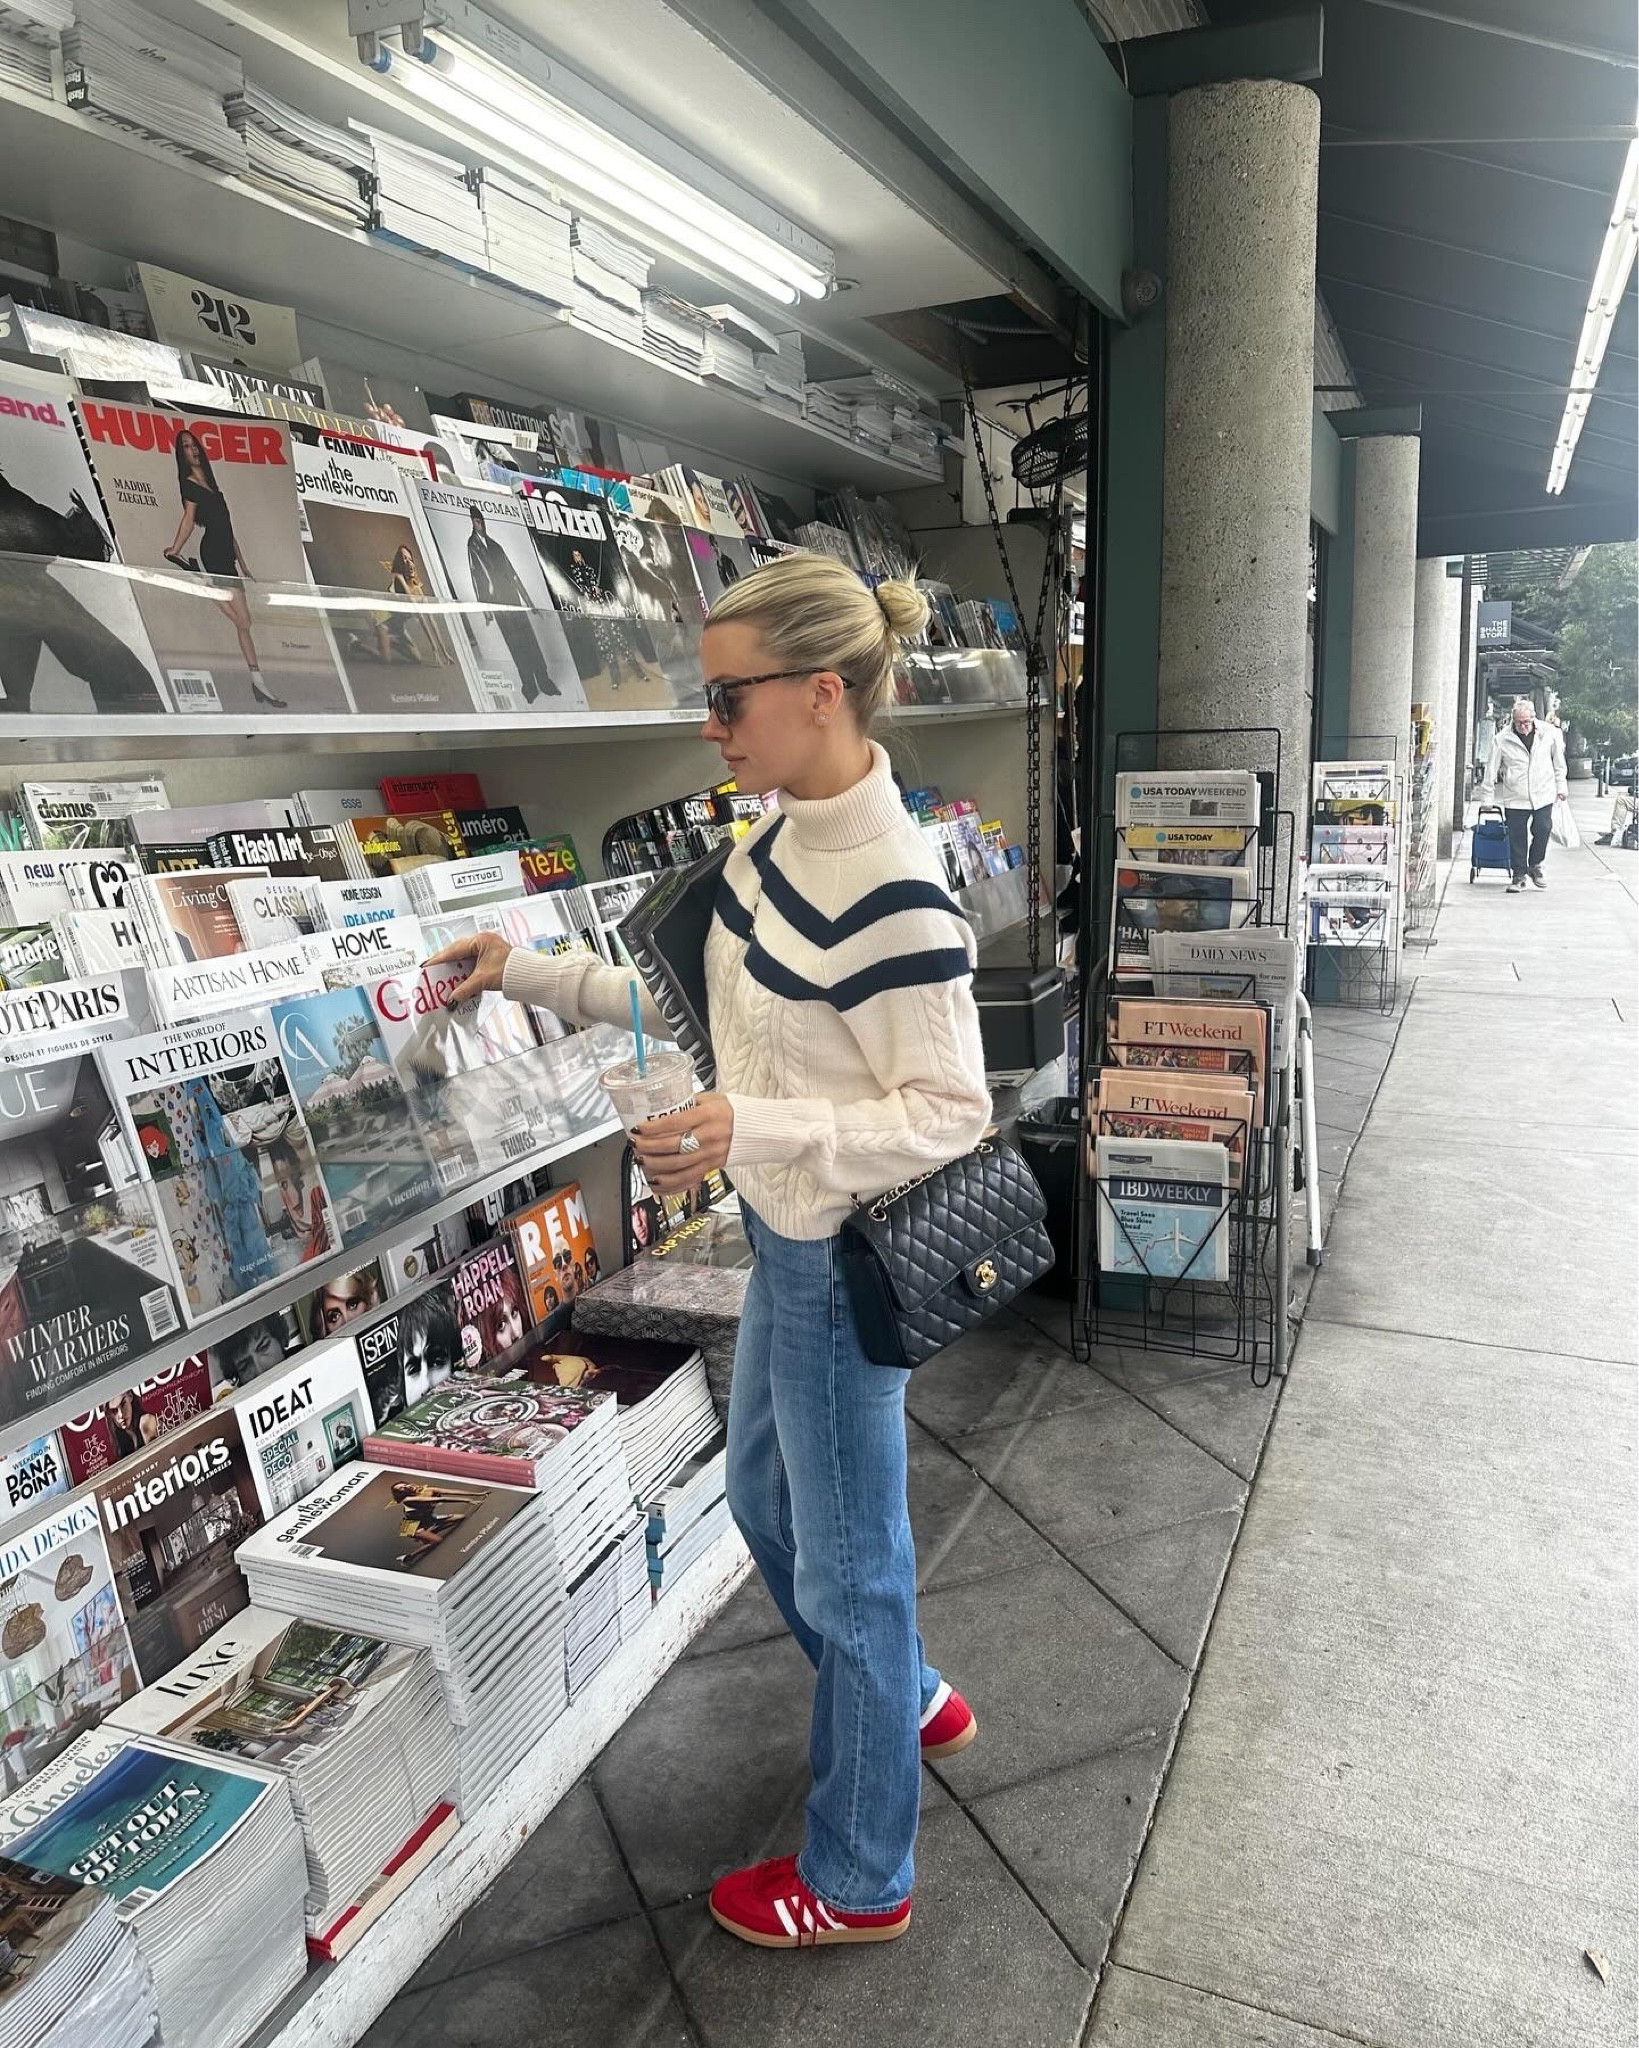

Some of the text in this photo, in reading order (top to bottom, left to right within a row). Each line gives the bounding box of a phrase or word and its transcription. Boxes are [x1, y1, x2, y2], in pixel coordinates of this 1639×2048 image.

[191, 289, 257, 346] 212
[81, 402, 288, 466] HUNGER
[328, 457, 354, 482] the
[113, 477, 153, 495] MADDIE
[117, 490, 159, 508] ZIEGLER
[295, 470, 399, 504] gentlewoman
[531, 496, 607, 541] DAZED
[1143, 786, 1247, 797] USA TODAY WEEKEND
[37, 798, 98, 819] domus
[231, 830, 308, 866] Flash Art
[503, 829, 526, 844] art
[1167, 833, 1213, 841] USA TODAY
[456, 870, 500, 886] ATTITUDE
[168, 887, 217, 910] Living
[340, 885, 383, 903] HOME DESIGN
[331, 925, 392, 961] HOME
[1190, 947, 1267, 962] DAILY NEWS
[172, 967, 247, 1001] ARTISAN
[248, 956, 305, 986] HOME
[92, 1032, 114, 1044] STYLE
[163, 1022, 227, 1047] THE WORLD OF
[1143, 1021, 1243, 1041] FT Weekend
[124, 1024, 268, 1084] INTERIORS
[1130, 1095, 1229, 1118] FT Weekend
[500, 1130, 537, 1159] THINGS
[1120, 1180, 1212, 1202] IBD WEEKLY
[1120, 1209, 1139, 1217] Travel
[452, 1244, 515, 1300] HAPPELL
[462, 1275, 506, 1321] ROAN
[6, 1304, 95, 1364] WINTER
[29, 1313, 133, 1383] WARMERS
[364, 1320, 398, 1365] SPIN
[25, 1342, 130, 1402] FINDING COMFORT IN INTERIORS
[155, 1392, 199, 1422] HOLIDAY
[164, 1386, 184, 1406] THE
[248, 1377, 314, 1439] IDEAT
[156, 1403, 201, 1438] FASHION
[80, 1438, 108, 1466] LOOKS
[83, 1432, 98, 1449] THE
[261, 1432, 300, 1465] SPECIAL
[5, 1452, 57, 1492] DANA
[12, 1448, 45, 1471] WEEKEND
[132, 1460, 159, 1482] LUXURY
[193, 1459, 233, 1488] LOS ANGELES
[264, 1452, 293, 1479] DECO
[9, 1469, 59, 1508] POINT
[101, 1437, 230, 1535] Interiors
[275, 1470, 370, 1544] gentlewoman
[297, 1496, 326, 1515] the
[33, 1504, 99, 1556] DESIGN
[155, 1641, 243, 1699] luxe
[9, 1740, 124, 1829] Angeles
[69, 1829, 125, 1877] GET
[126, 1780, 179, 1833] OUT
[82, 1852, 121, 1886] OF
[121, 1781, 202, 1856] TOWN
